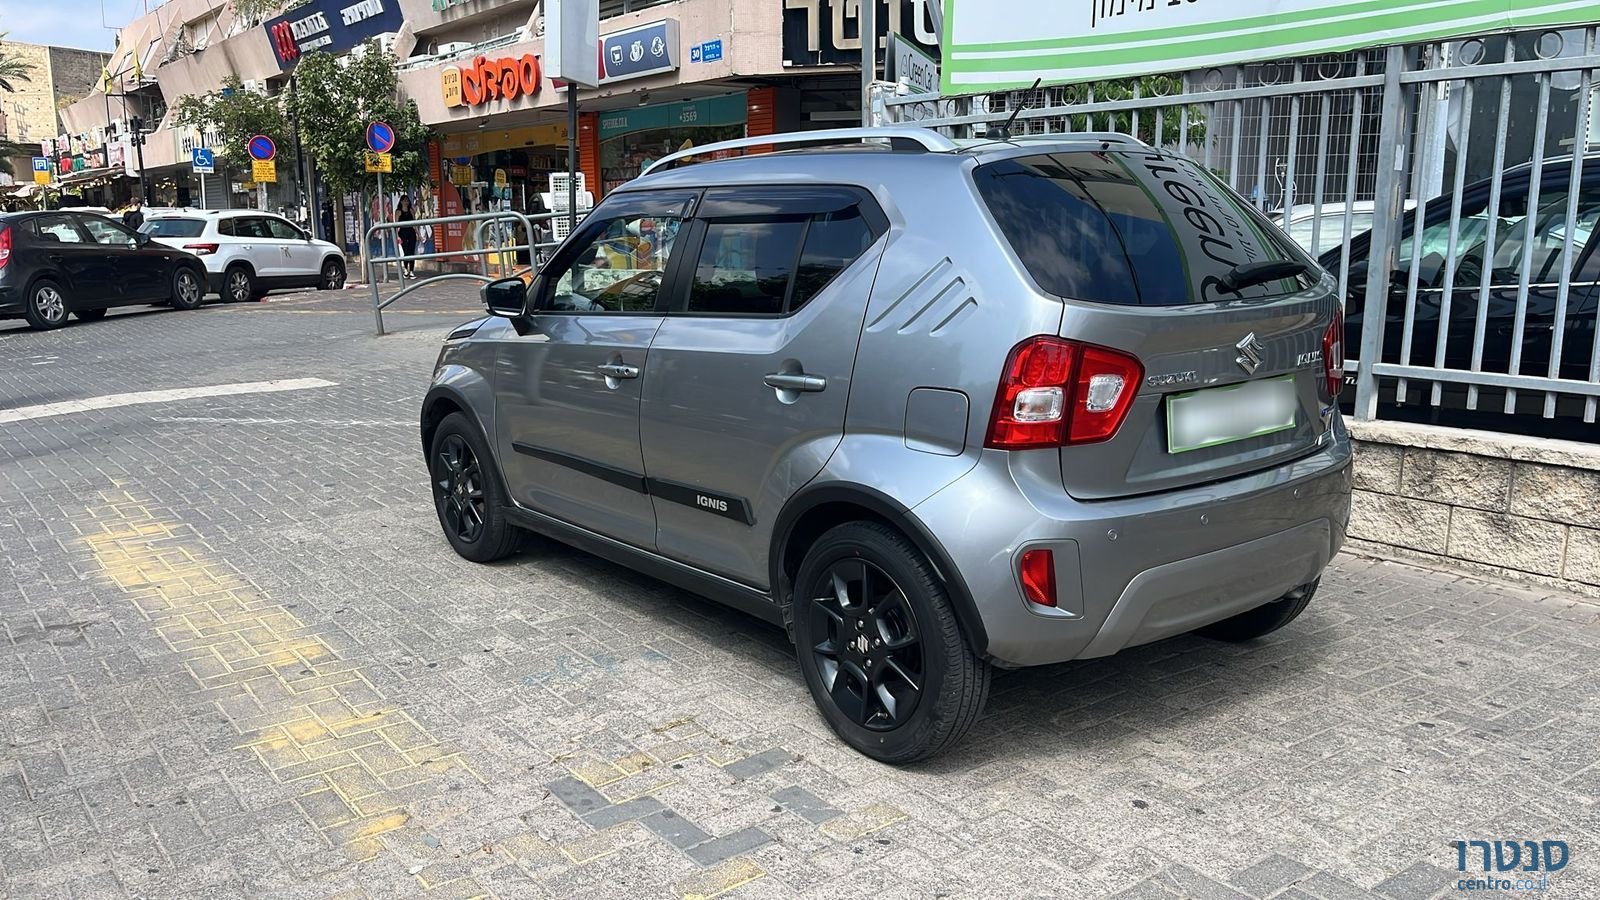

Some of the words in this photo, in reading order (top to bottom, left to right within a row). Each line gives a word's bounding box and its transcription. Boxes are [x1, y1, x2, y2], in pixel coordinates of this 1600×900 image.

[692, 49, 700, 60] 30
[908, 53, 925, 88] Green
[1147, 370, 1198, 387] SUZUKI
[696, 494, 728, 512] IGNIS
